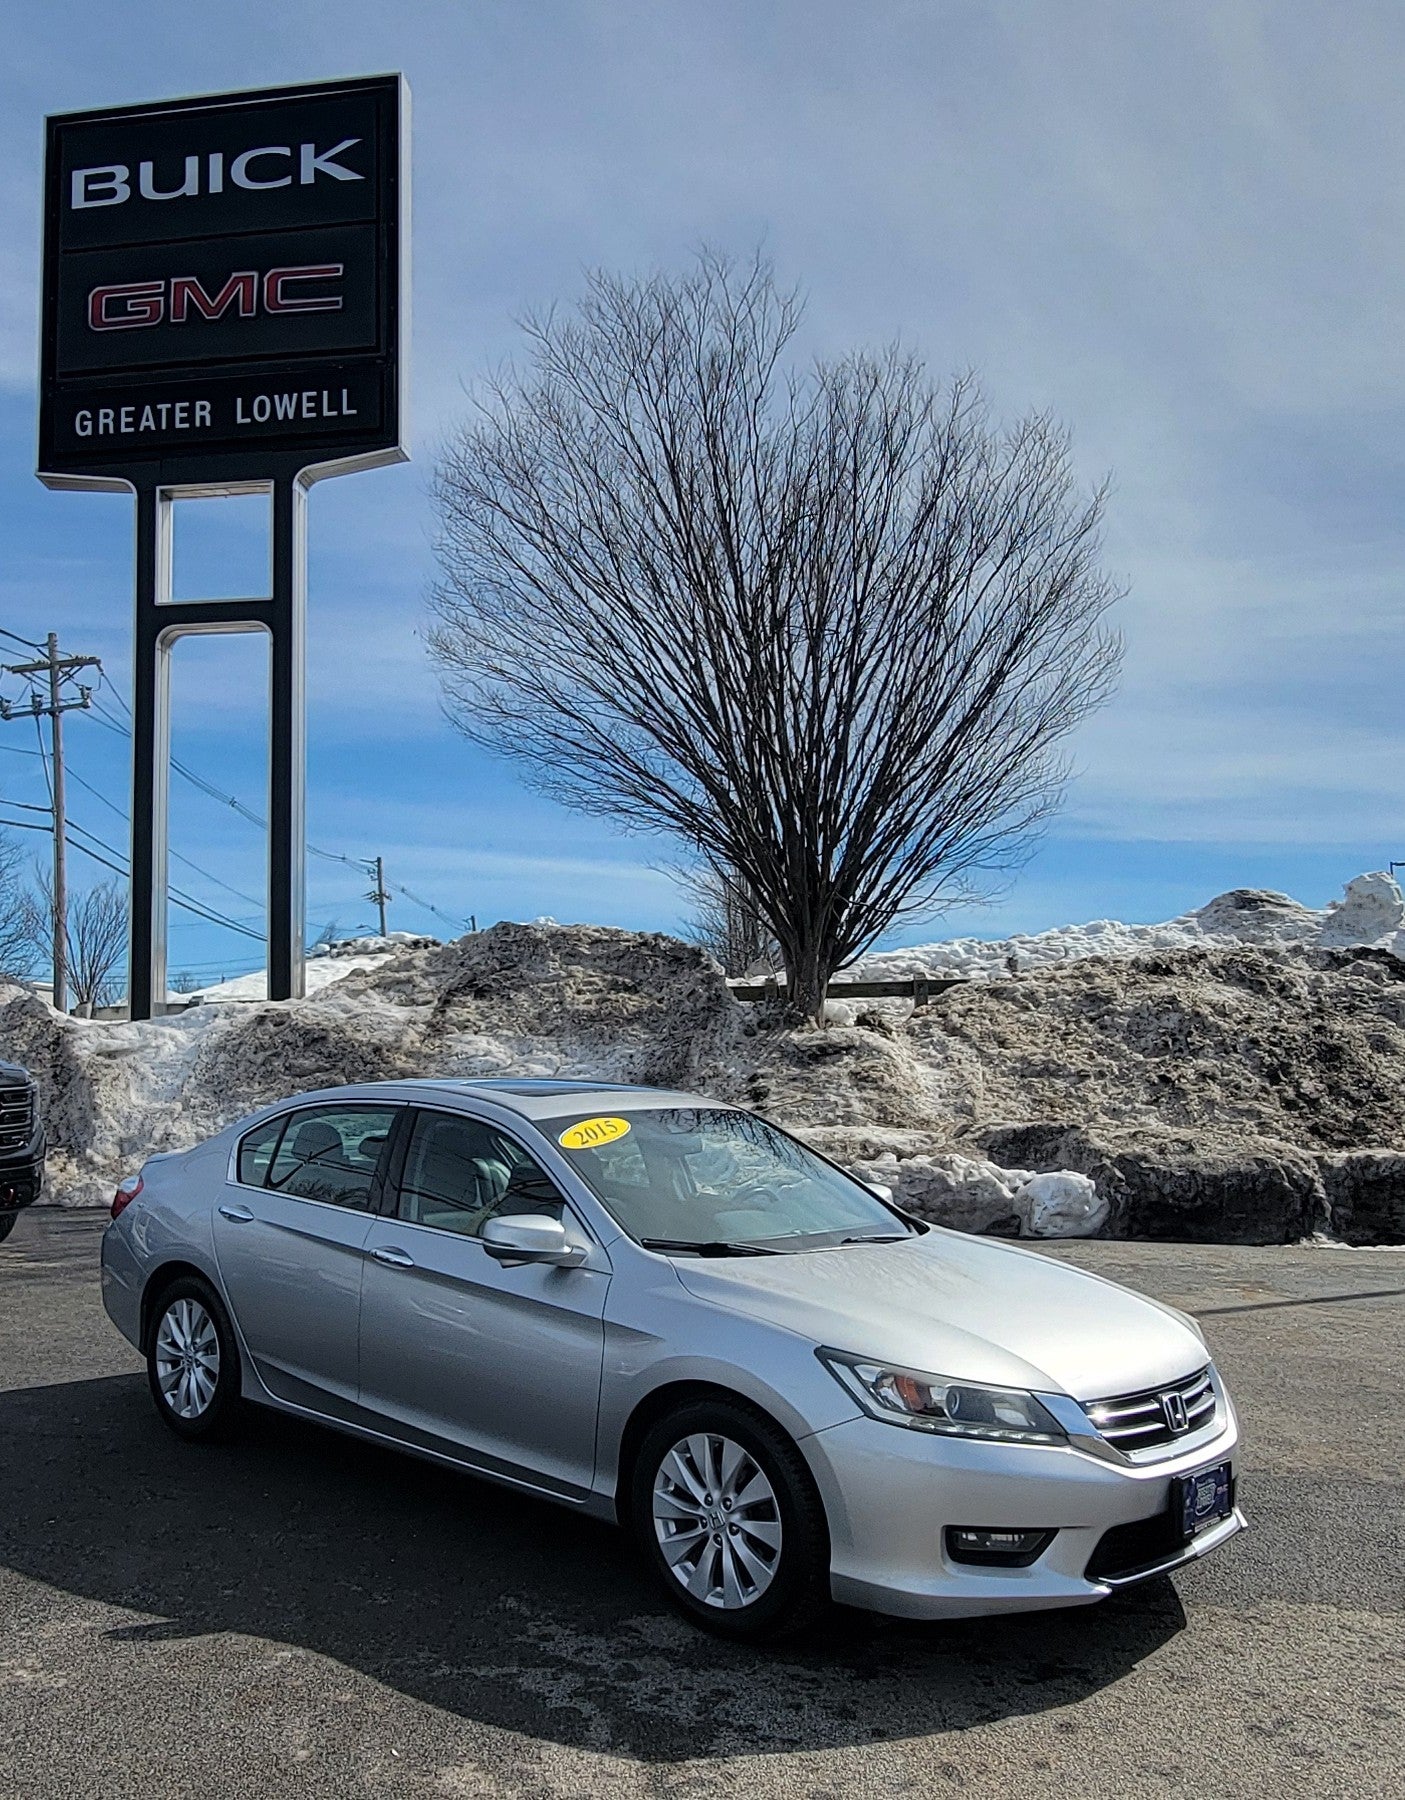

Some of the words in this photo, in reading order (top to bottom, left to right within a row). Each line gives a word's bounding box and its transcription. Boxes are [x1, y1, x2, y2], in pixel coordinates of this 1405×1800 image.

[71, 138, 366, 210] BUICK
[88, 263, 344, 331] GMC
[75, 400, 212, 437] GREATER
[236, 388, 358, 425] LOWELL
[573, 1120, 618, 1145] 2015
